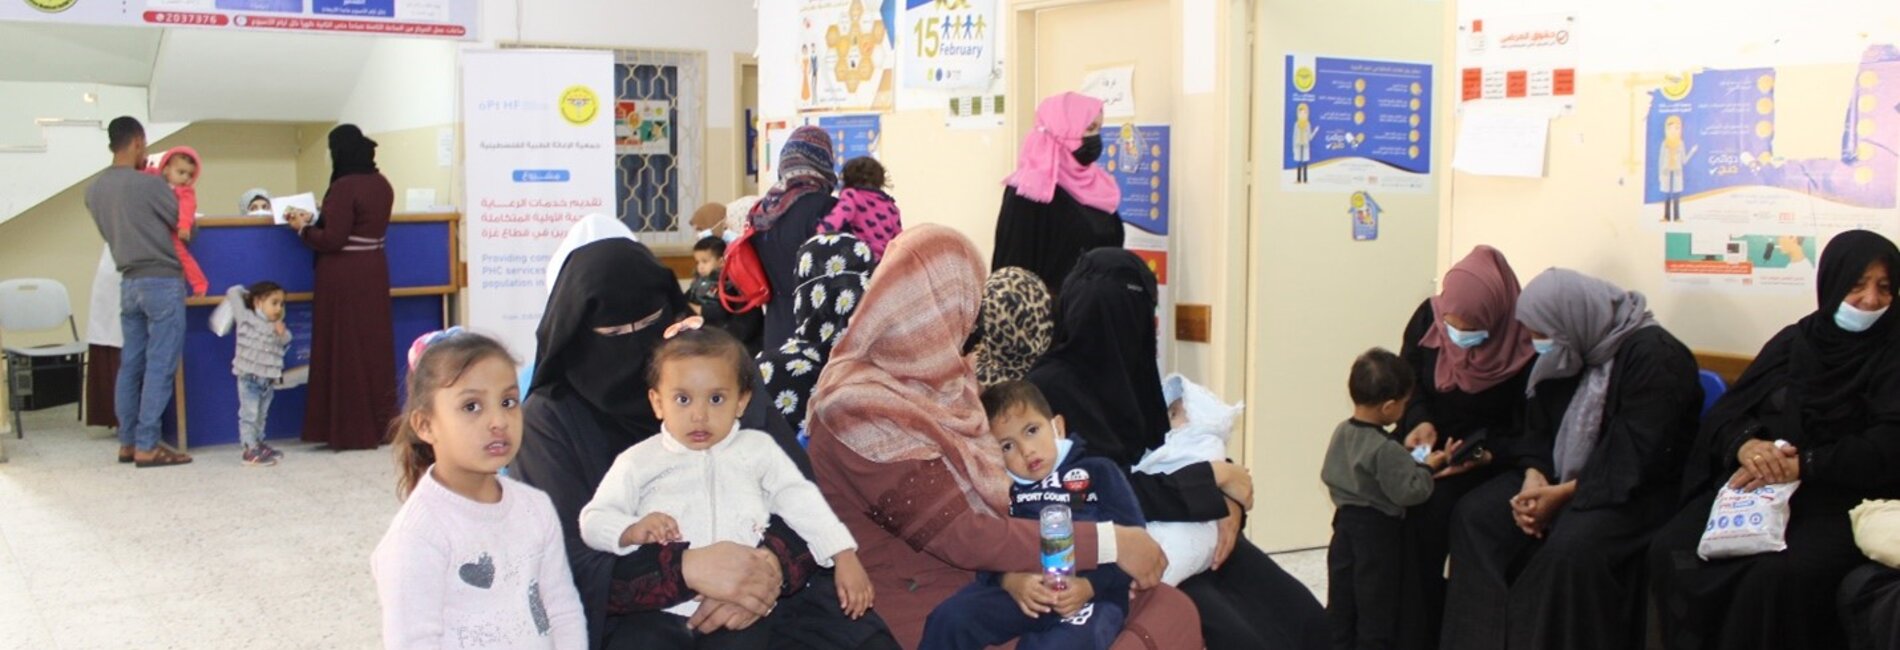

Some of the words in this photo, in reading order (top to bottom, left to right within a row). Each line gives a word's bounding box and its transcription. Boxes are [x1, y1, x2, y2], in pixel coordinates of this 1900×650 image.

[914, 17, 940, 58] 15
[940, 42, 983, 59] February
[528, 198, 567, 208] خدمات
[569, 197, 602, 208] تقديم
[482, 254, 527, 264] Providing
[482, 266, 502, 275] PHC
[506, 267, 546, 275] services
[482, 280, 533, 289] population
[1016, 492, 1043, 503] SPORT
